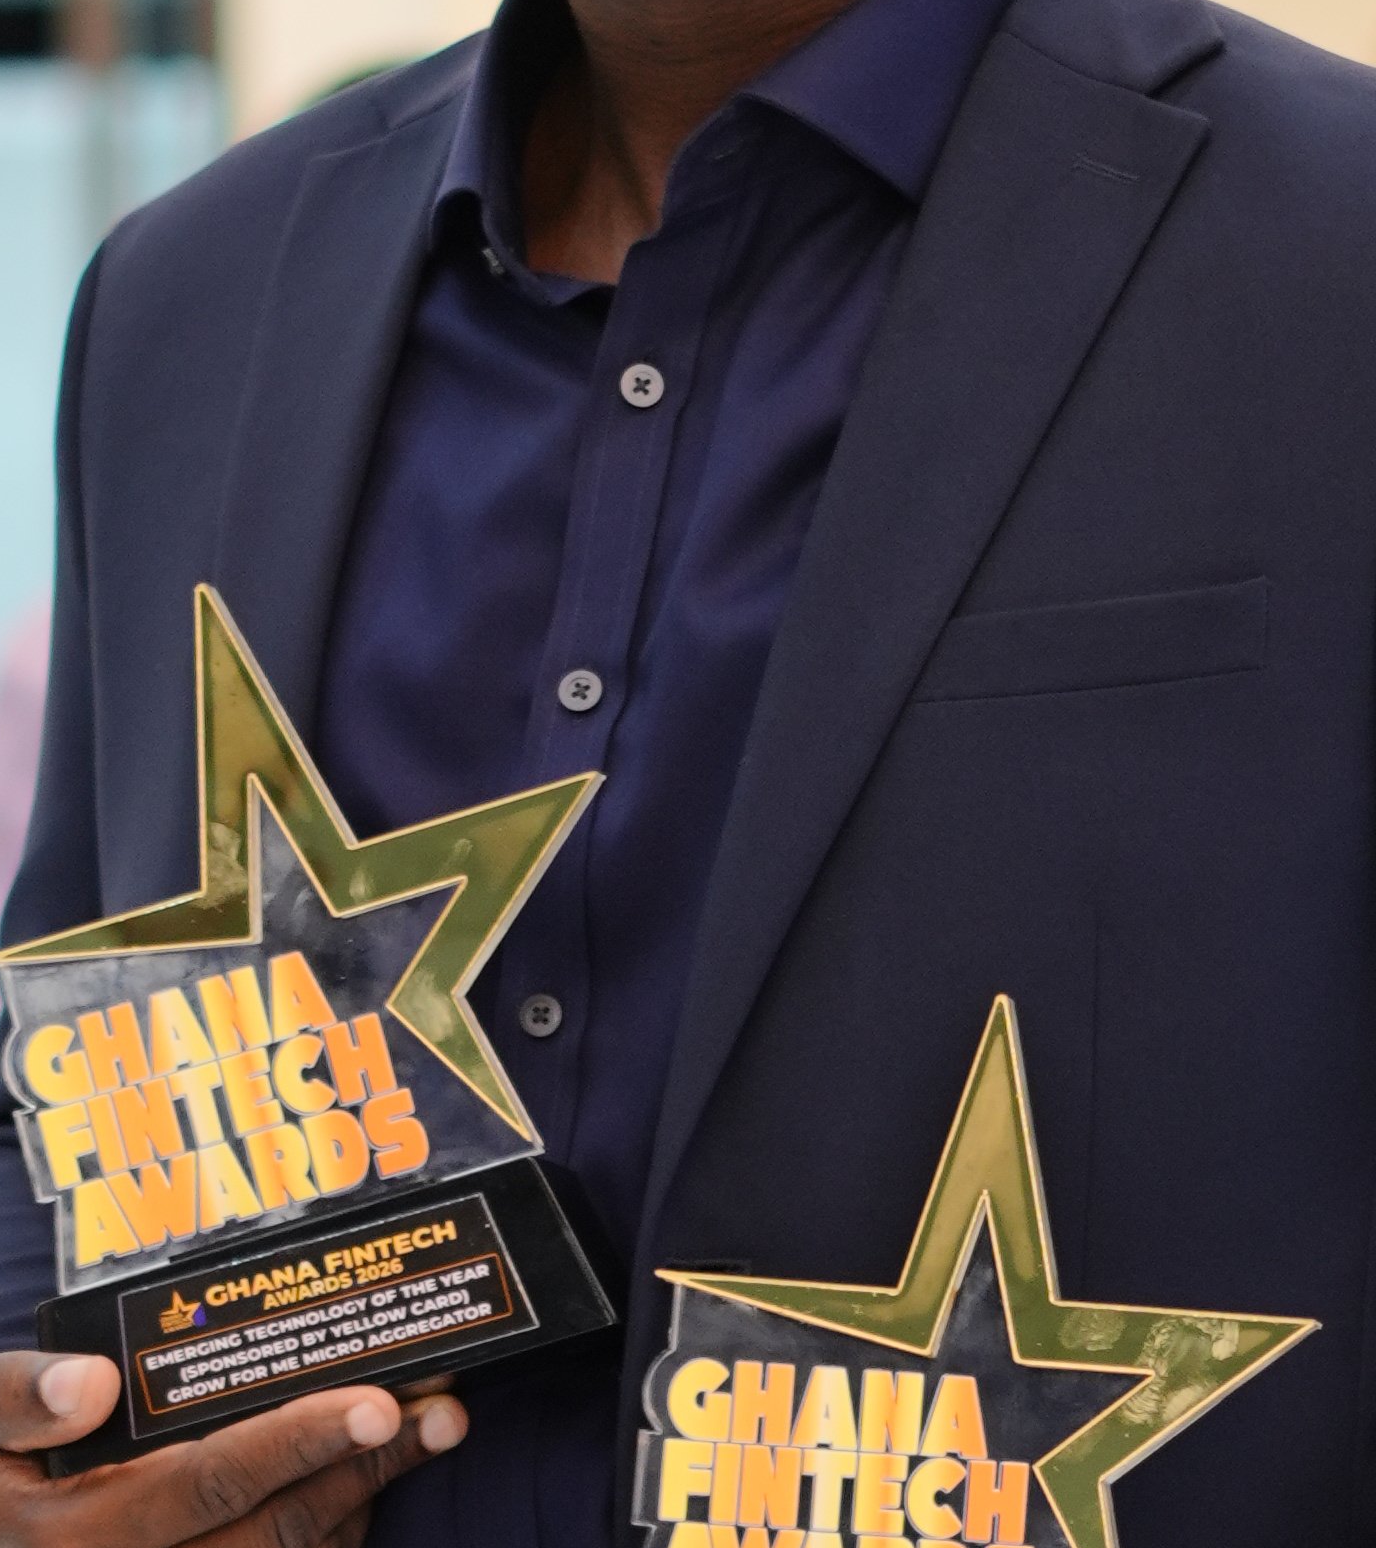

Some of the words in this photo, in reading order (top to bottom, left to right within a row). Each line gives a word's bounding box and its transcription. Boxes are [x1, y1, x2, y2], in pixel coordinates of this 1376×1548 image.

[26, 951, 337, 1105] GHANA
[37, 1012, 397, 1189] FINTECH
[75, 1088, 429, 1266] AWARDS
[205, 1260, 320, 1306] GHANA
[323, 1220, 457, 1274] FINTECH
[263, 1272, 353, 1310] AWARDS
[355, 1257, 404, 1284] 2026
[146, 1333, 242, 1371] EMERGING
[245, 1297, 368, 1342] TECHNOLOGY
[371, 1289, 398, 1307] OF
[399, 1278, 438, 1298] THE
[439, 1264, 490, 1287] YEAR
[167, 1377, 225, 1403] GROW
[229, 1365, 268, 1386] FOR
[271, 1356, 301, 1375] ME
[302, 1339, 364, 1365] MICRO
[367, 1303, 492, 1348] AGGREGATOR
[180, 1338, 299, 1382] (SPONSORED
[301, 1328, 327, 1346] BY
[329, 1306, 407, 1338] YELLOW
[410, 1289, 470, 1316] CARD)
[667, 1358, 987, 1459] GHANA
[658, 1438, 1030, 1545] FINTECH
